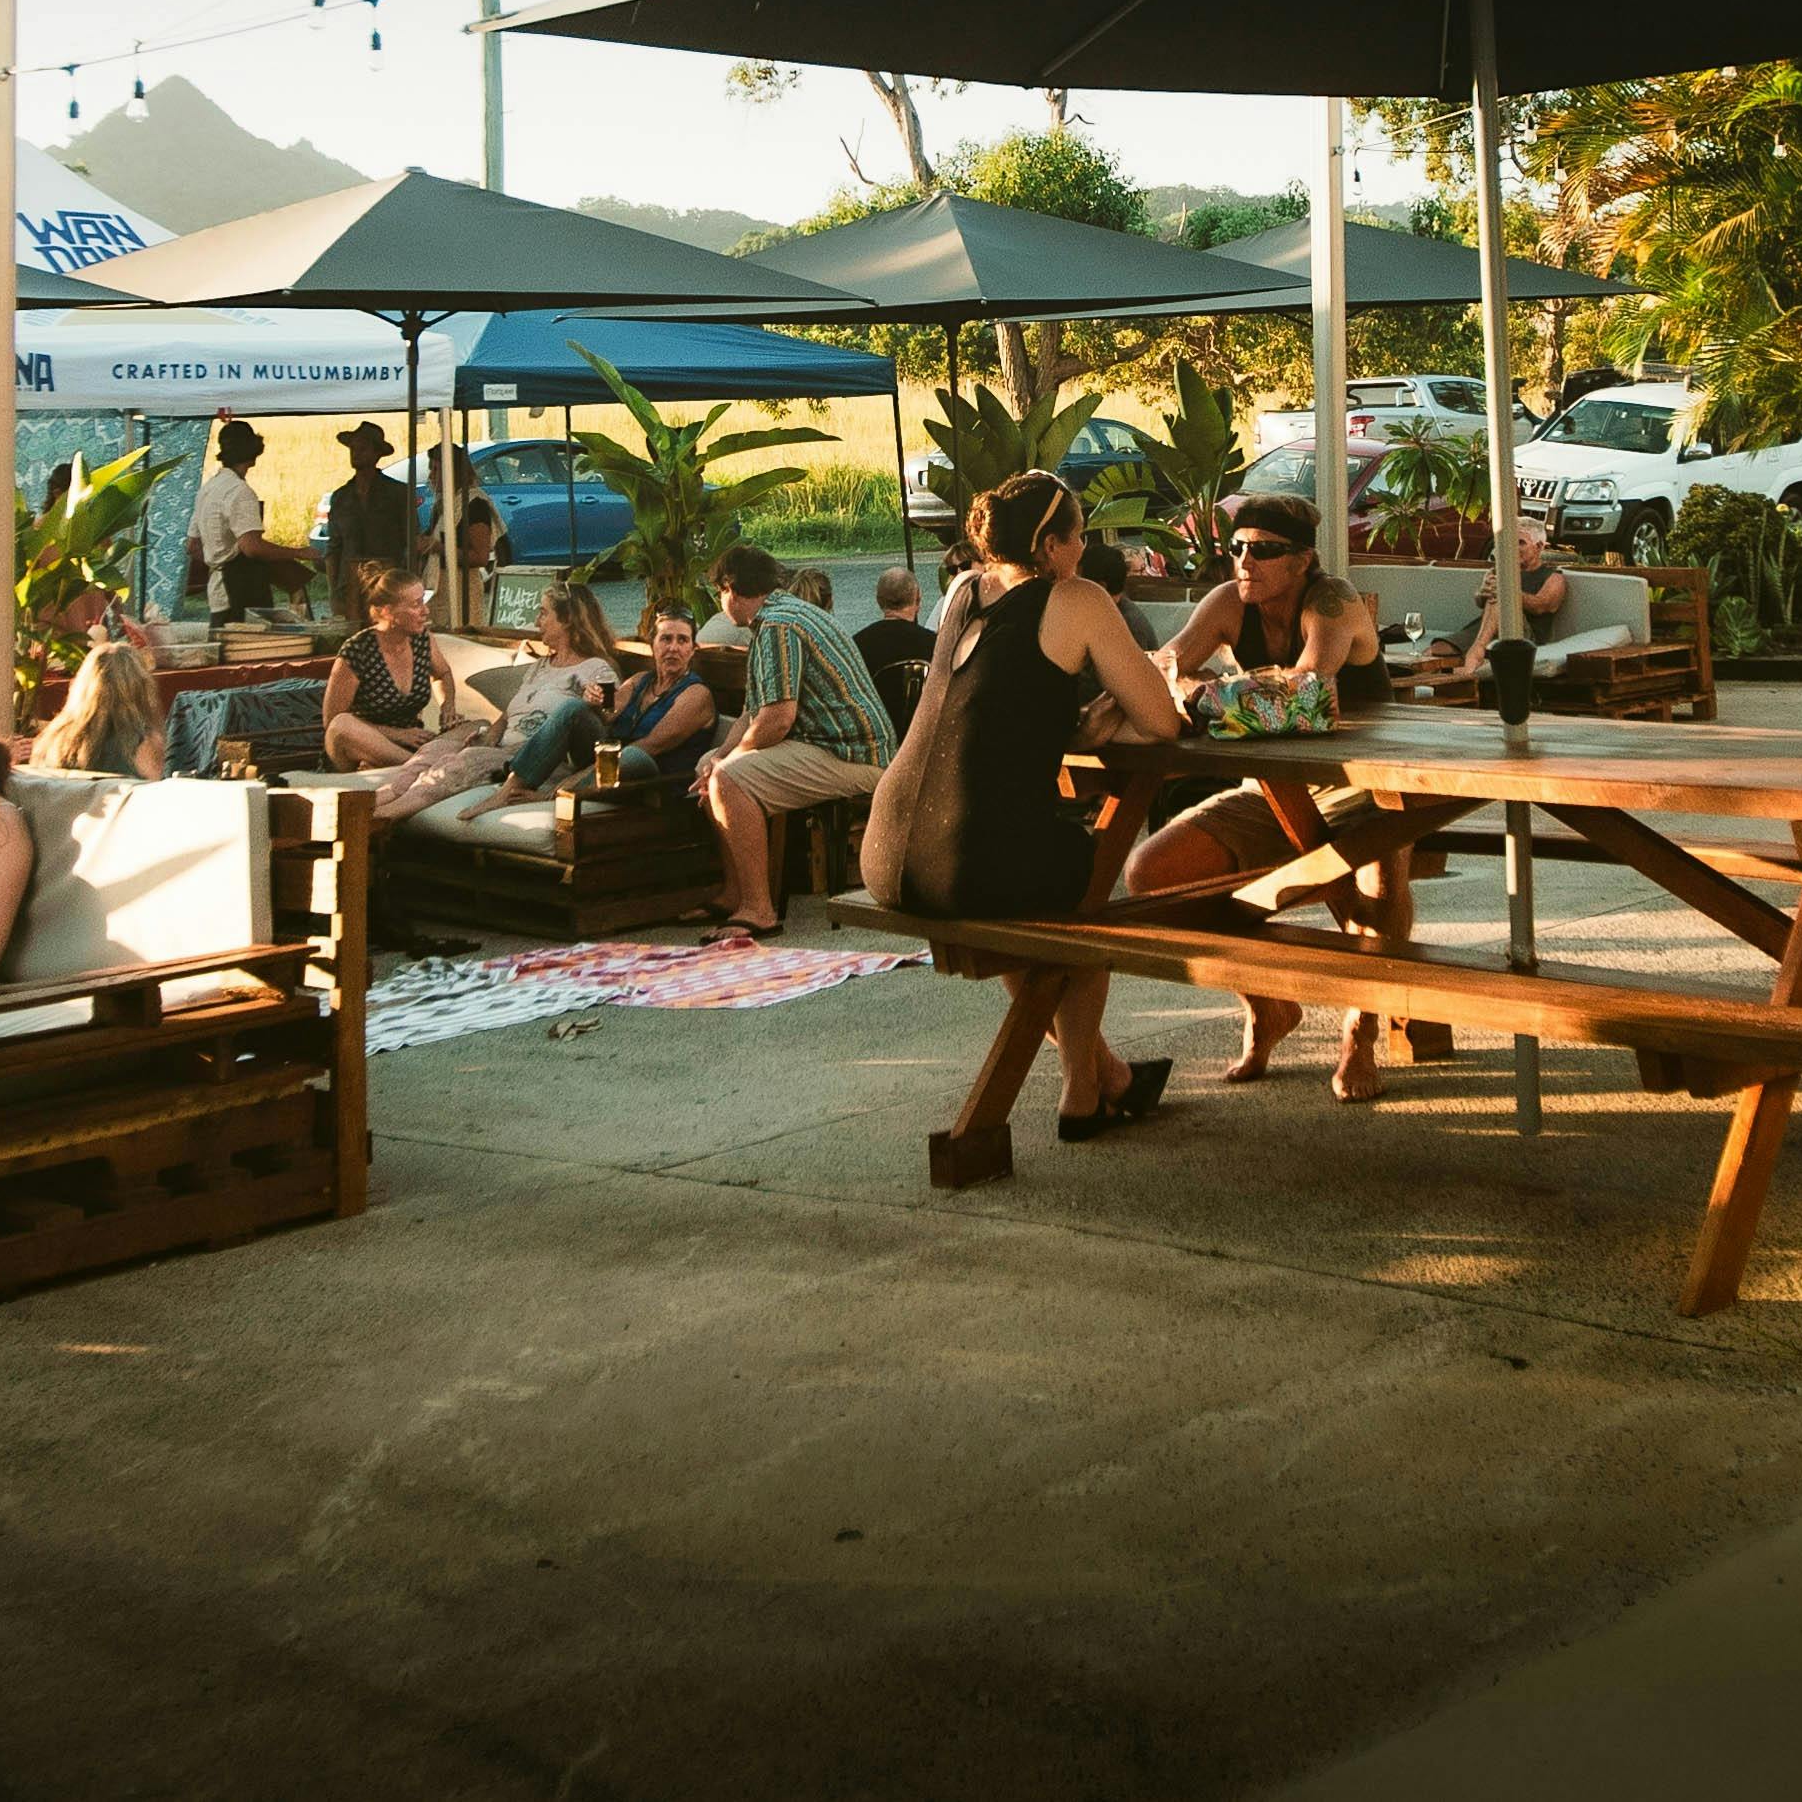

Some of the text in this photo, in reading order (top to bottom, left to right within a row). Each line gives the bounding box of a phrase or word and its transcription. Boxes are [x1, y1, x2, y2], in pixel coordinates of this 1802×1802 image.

[16, 210, 147, 248] WAN
[112, 363, 404, 381] CRAFTED IN MULLUMBIMBY
